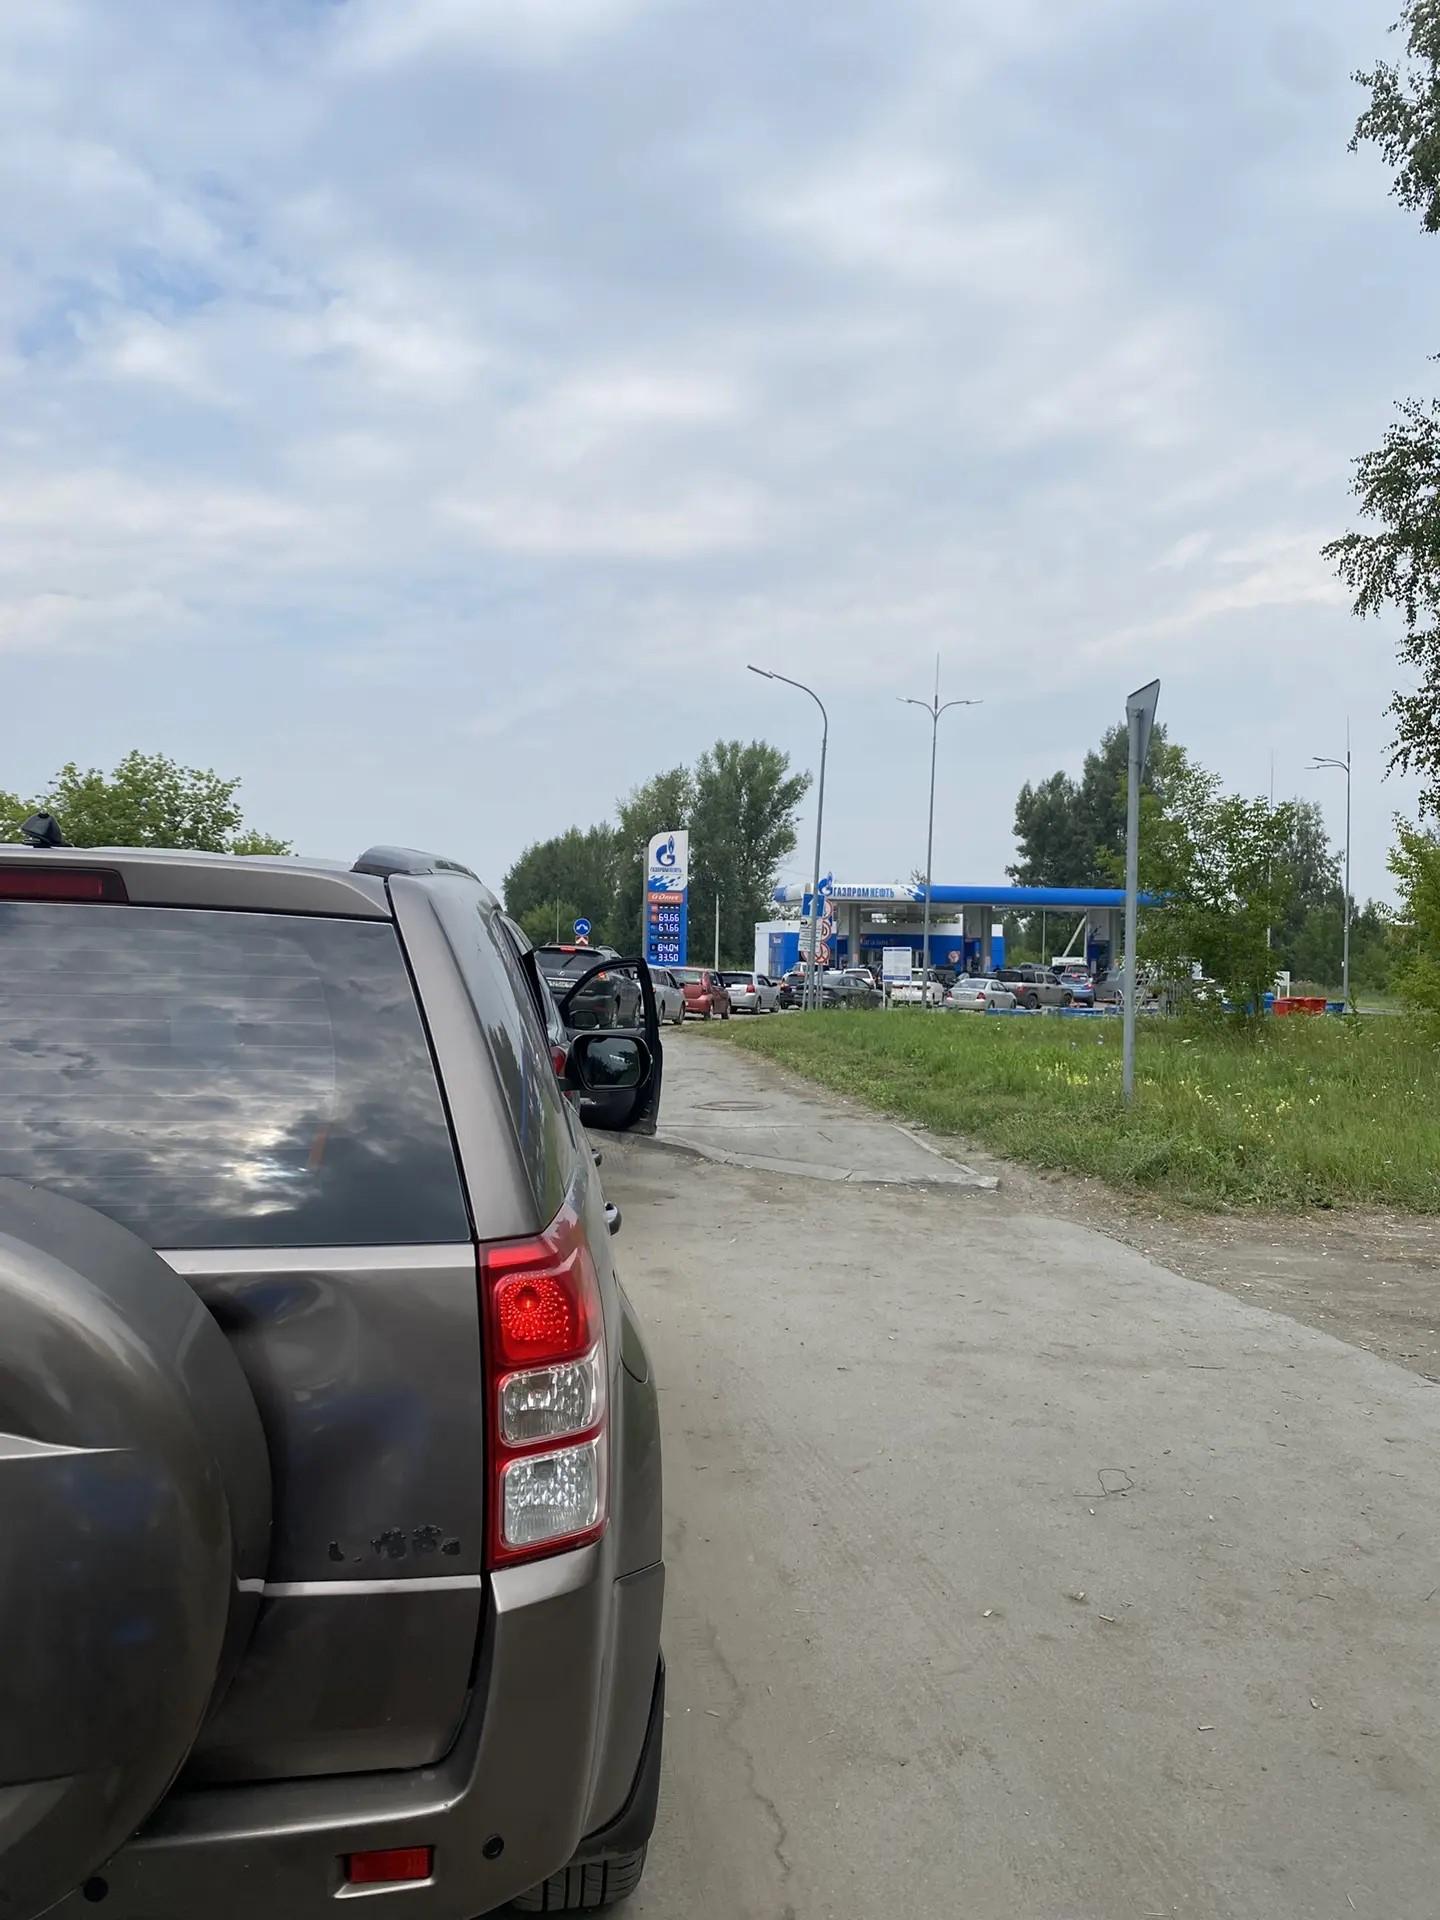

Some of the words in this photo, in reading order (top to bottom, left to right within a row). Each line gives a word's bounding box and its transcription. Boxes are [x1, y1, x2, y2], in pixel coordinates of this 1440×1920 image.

[832, 887, 895, 898] ГАЗПРОМНЕФТЬ
[658, 913, 680, 922] 69.66
[658, 923, 679, 932] 67.66
[658, 953, 679, 962] 33.50
